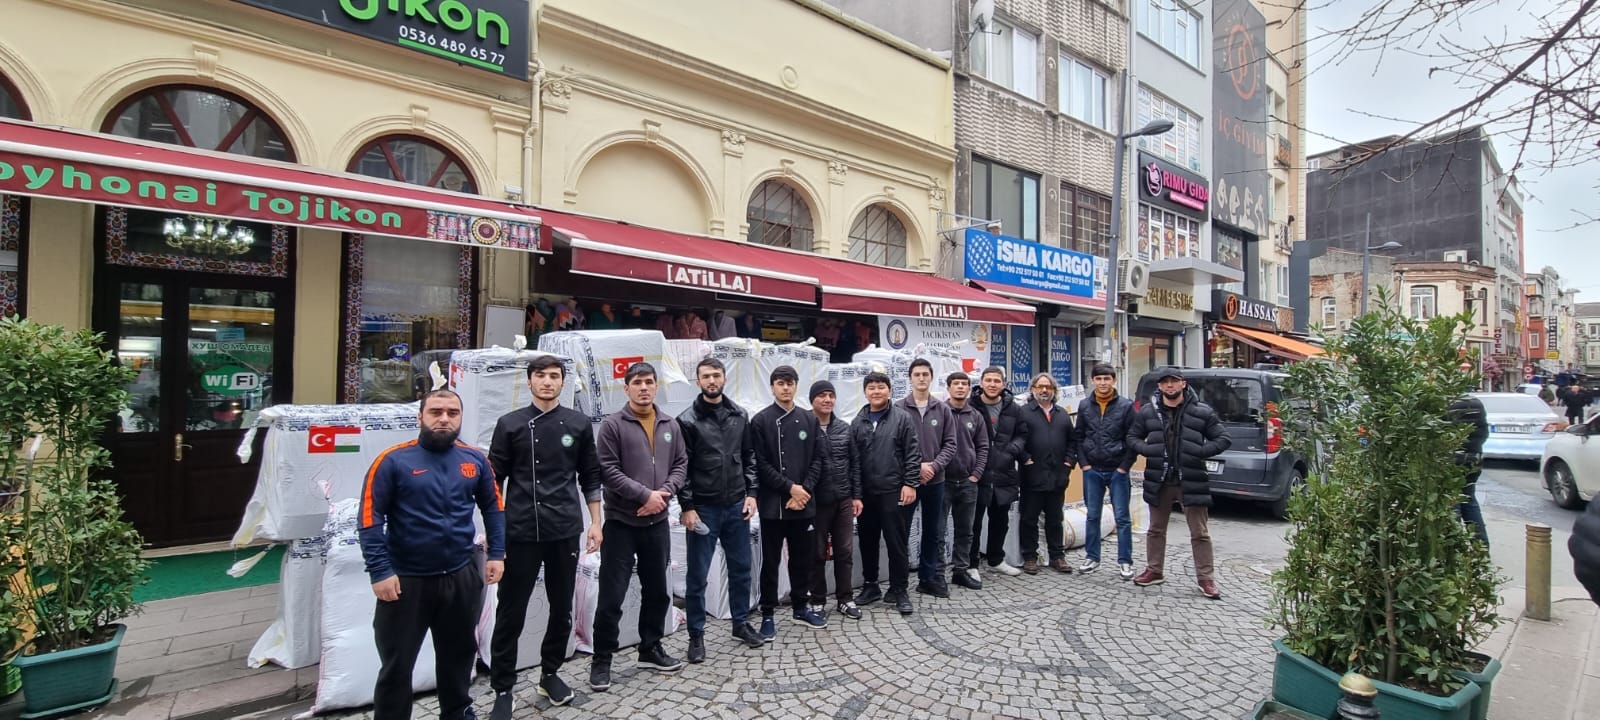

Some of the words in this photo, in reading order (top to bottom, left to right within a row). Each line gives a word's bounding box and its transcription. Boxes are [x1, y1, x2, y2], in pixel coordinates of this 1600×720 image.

[399, 25, 436, 46] 0536
[440, 38, 466, 54] 489
[470, 46, 487, 61] 65
[490, 51, 505, 65] 77
[1162, 170, 1187, 194] RIMU
[1189, 181, 1209, 202] GIDA
[242, 190, 401, 228] Tojikon
[1041, 249, 1092, 278] KARGO
[1239, 300, 1277, 322] HASSAS
